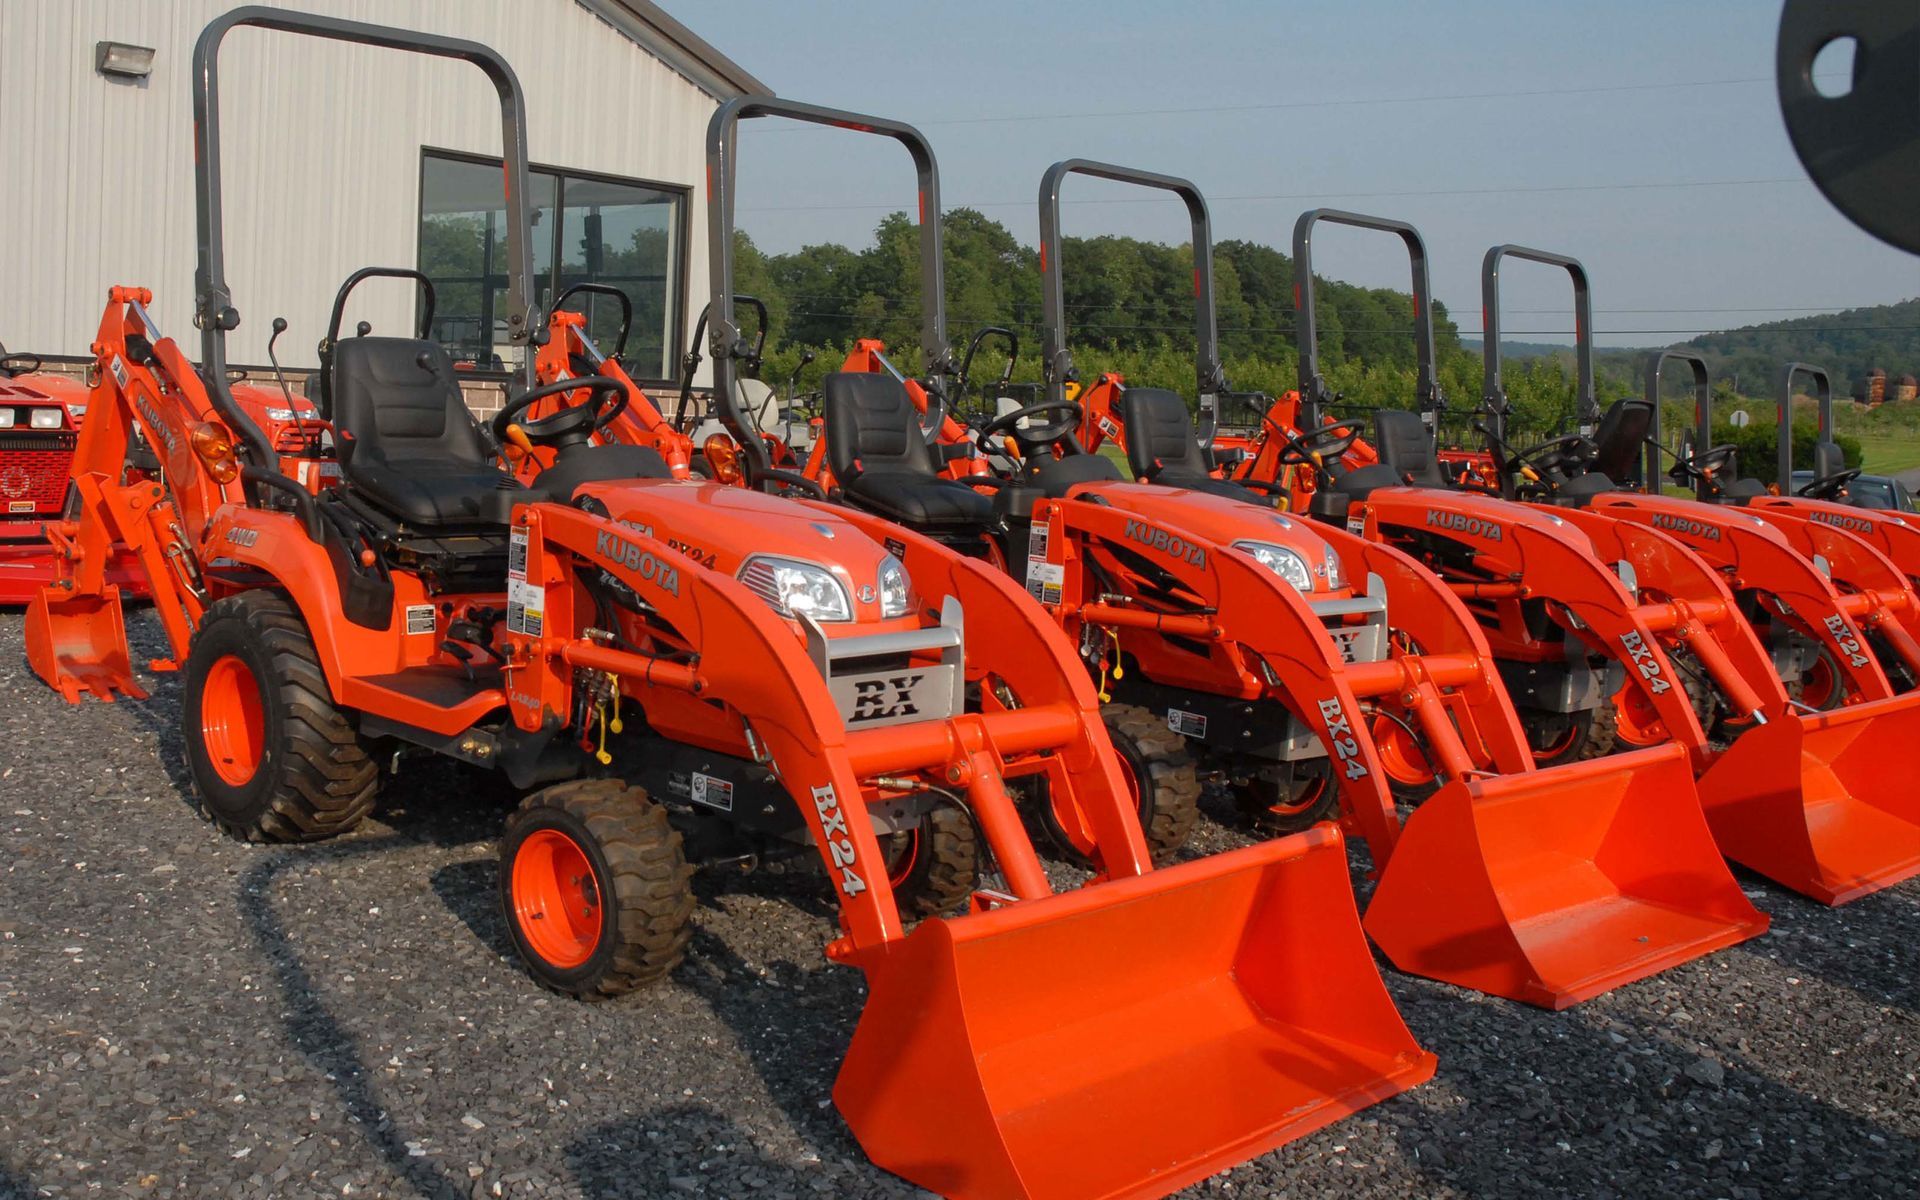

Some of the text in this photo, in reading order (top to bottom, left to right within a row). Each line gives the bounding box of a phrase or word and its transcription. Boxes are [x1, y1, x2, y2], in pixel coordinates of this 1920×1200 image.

[136, 394, 177, 456] KUBOTA
[225, 526, 258, 547] 4WD
[1124, 518, 1206, 571] KUBOTA
[1426, 509, 1503, 543] KUBOTA
[1651, 512, 1721, 543] KUBOTA
[1808, 511, 1874, 534] KUBOTA
[596, 528, 680, 599] KUBOTA
[1618, 628, 1671, 694] BX24
[1822, 612, 1869, 668] BX24
[848, 674, 925, 723] BX
[1317, 694, 1369, 781] BX24
[808, 781, 867, 898] BX24
